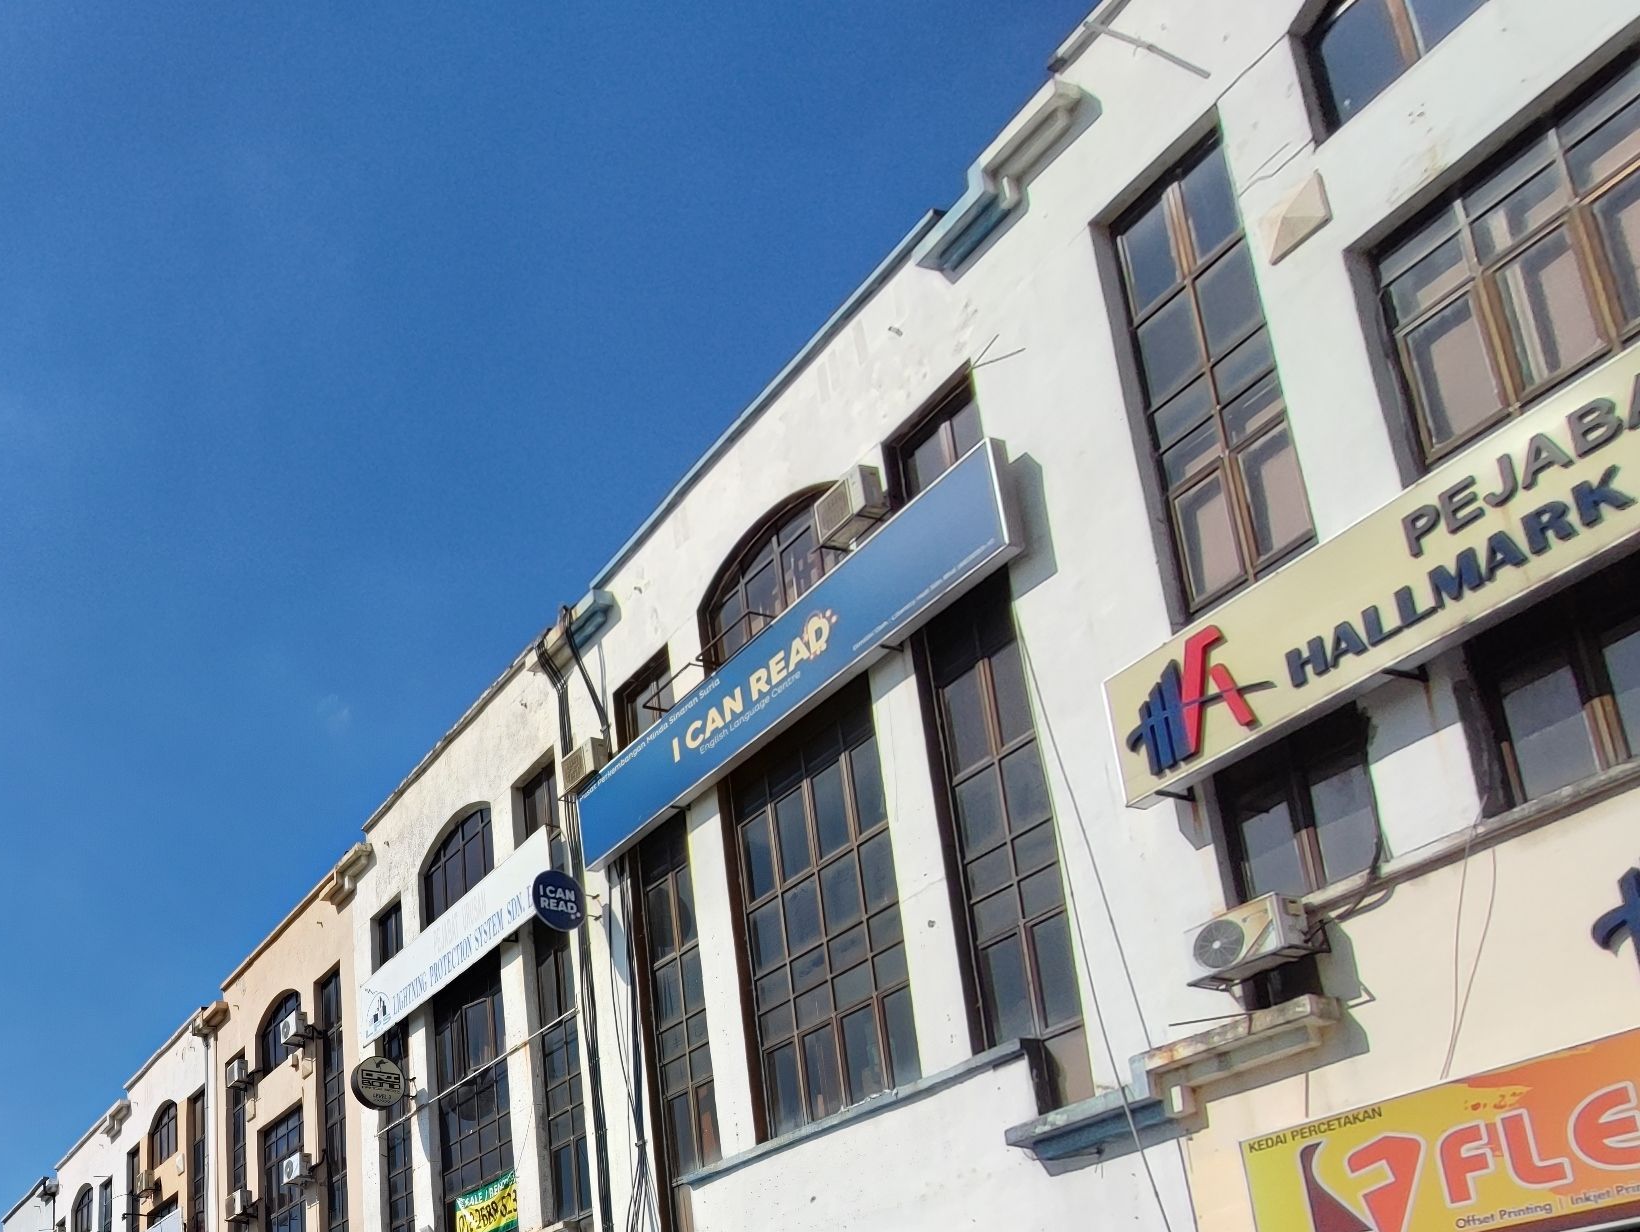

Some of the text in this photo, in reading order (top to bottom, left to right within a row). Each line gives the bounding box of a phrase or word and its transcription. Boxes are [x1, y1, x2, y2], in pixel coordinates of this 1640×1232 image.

[1401, 373, 1640, 558] PEJAB
[1285, 464, 1638, 688] HALLMARK
[597, 740, 647, 786] Perkembangan
[646, 722, 669, 744] Minda
[668, 694, 699, 725] Sinaran
[699, 677, 721, 699] Suria
[671, 614, 831, 763] I CAN READ
[699, 670, 802, 755] English Language Centre
[539, 884, 544, 896] I
[546, 885, 577, 902] CAN
[540, 898, 578, 914] READ
[392, 970, 428, 1015] LIGHTNING
[429, 933, 472, 987] PROTECTION
[474, 911, 504, 949] SYSTEM
[1248, 1106, 1383, 1153] KEDAI PERCETAKAN
[1456, 1213, 1496, 1229] Offset
[1499, 1202, 1553, 1222] Printing
